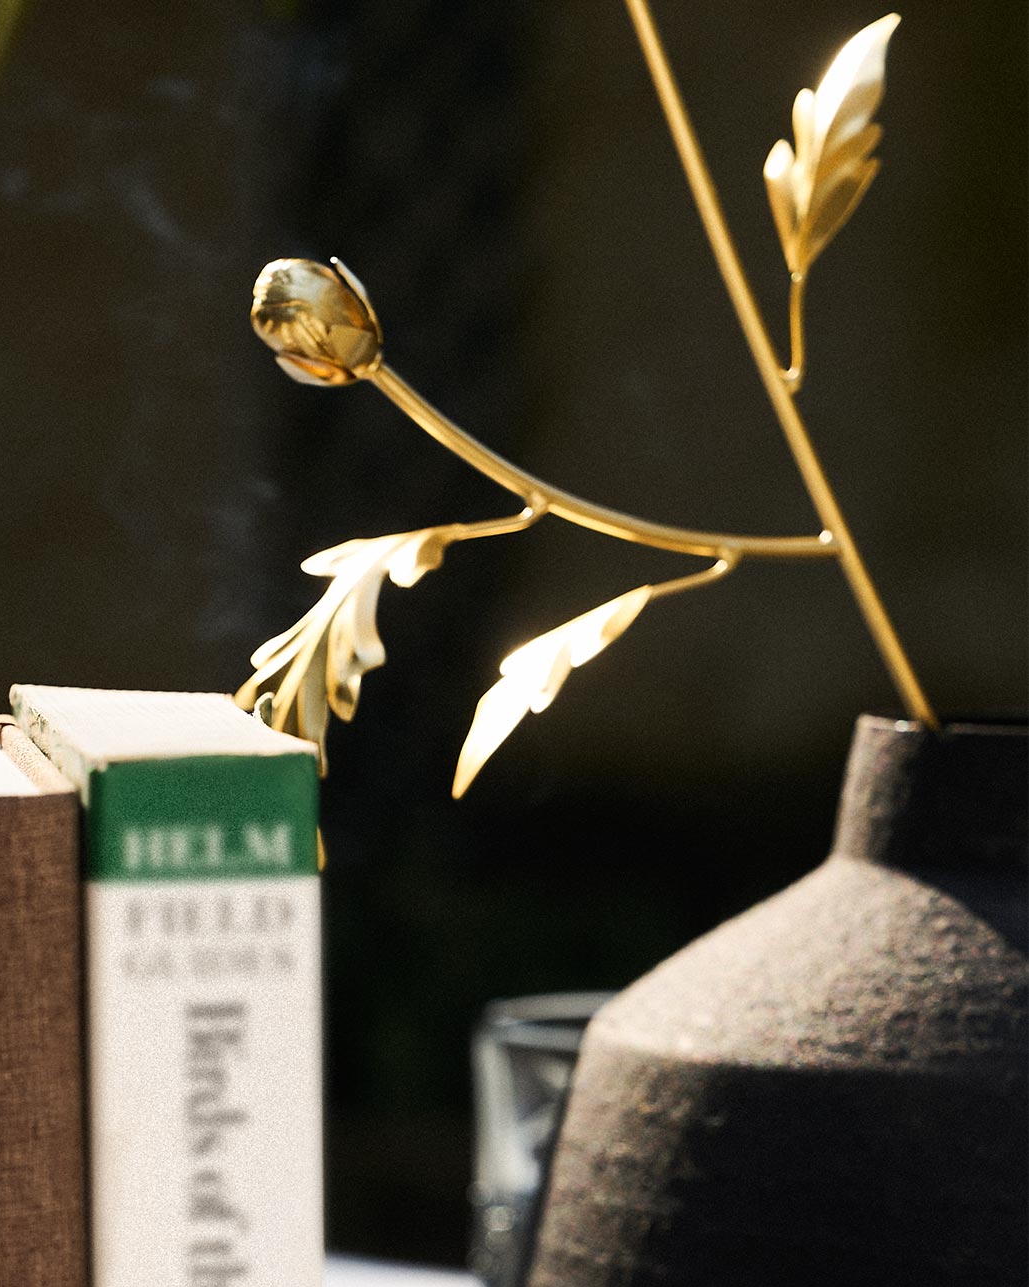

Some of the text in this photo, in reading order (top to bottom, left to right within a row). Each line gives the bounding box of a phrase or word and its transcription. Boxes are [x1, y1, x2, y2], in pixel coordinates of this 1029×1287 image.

[122, 823, 295, 870] HELM
[125, 896, 295, 936] FIELD
[185, 1001, 249, 1156] Birds
[187, 1167, 250, 1233] of
